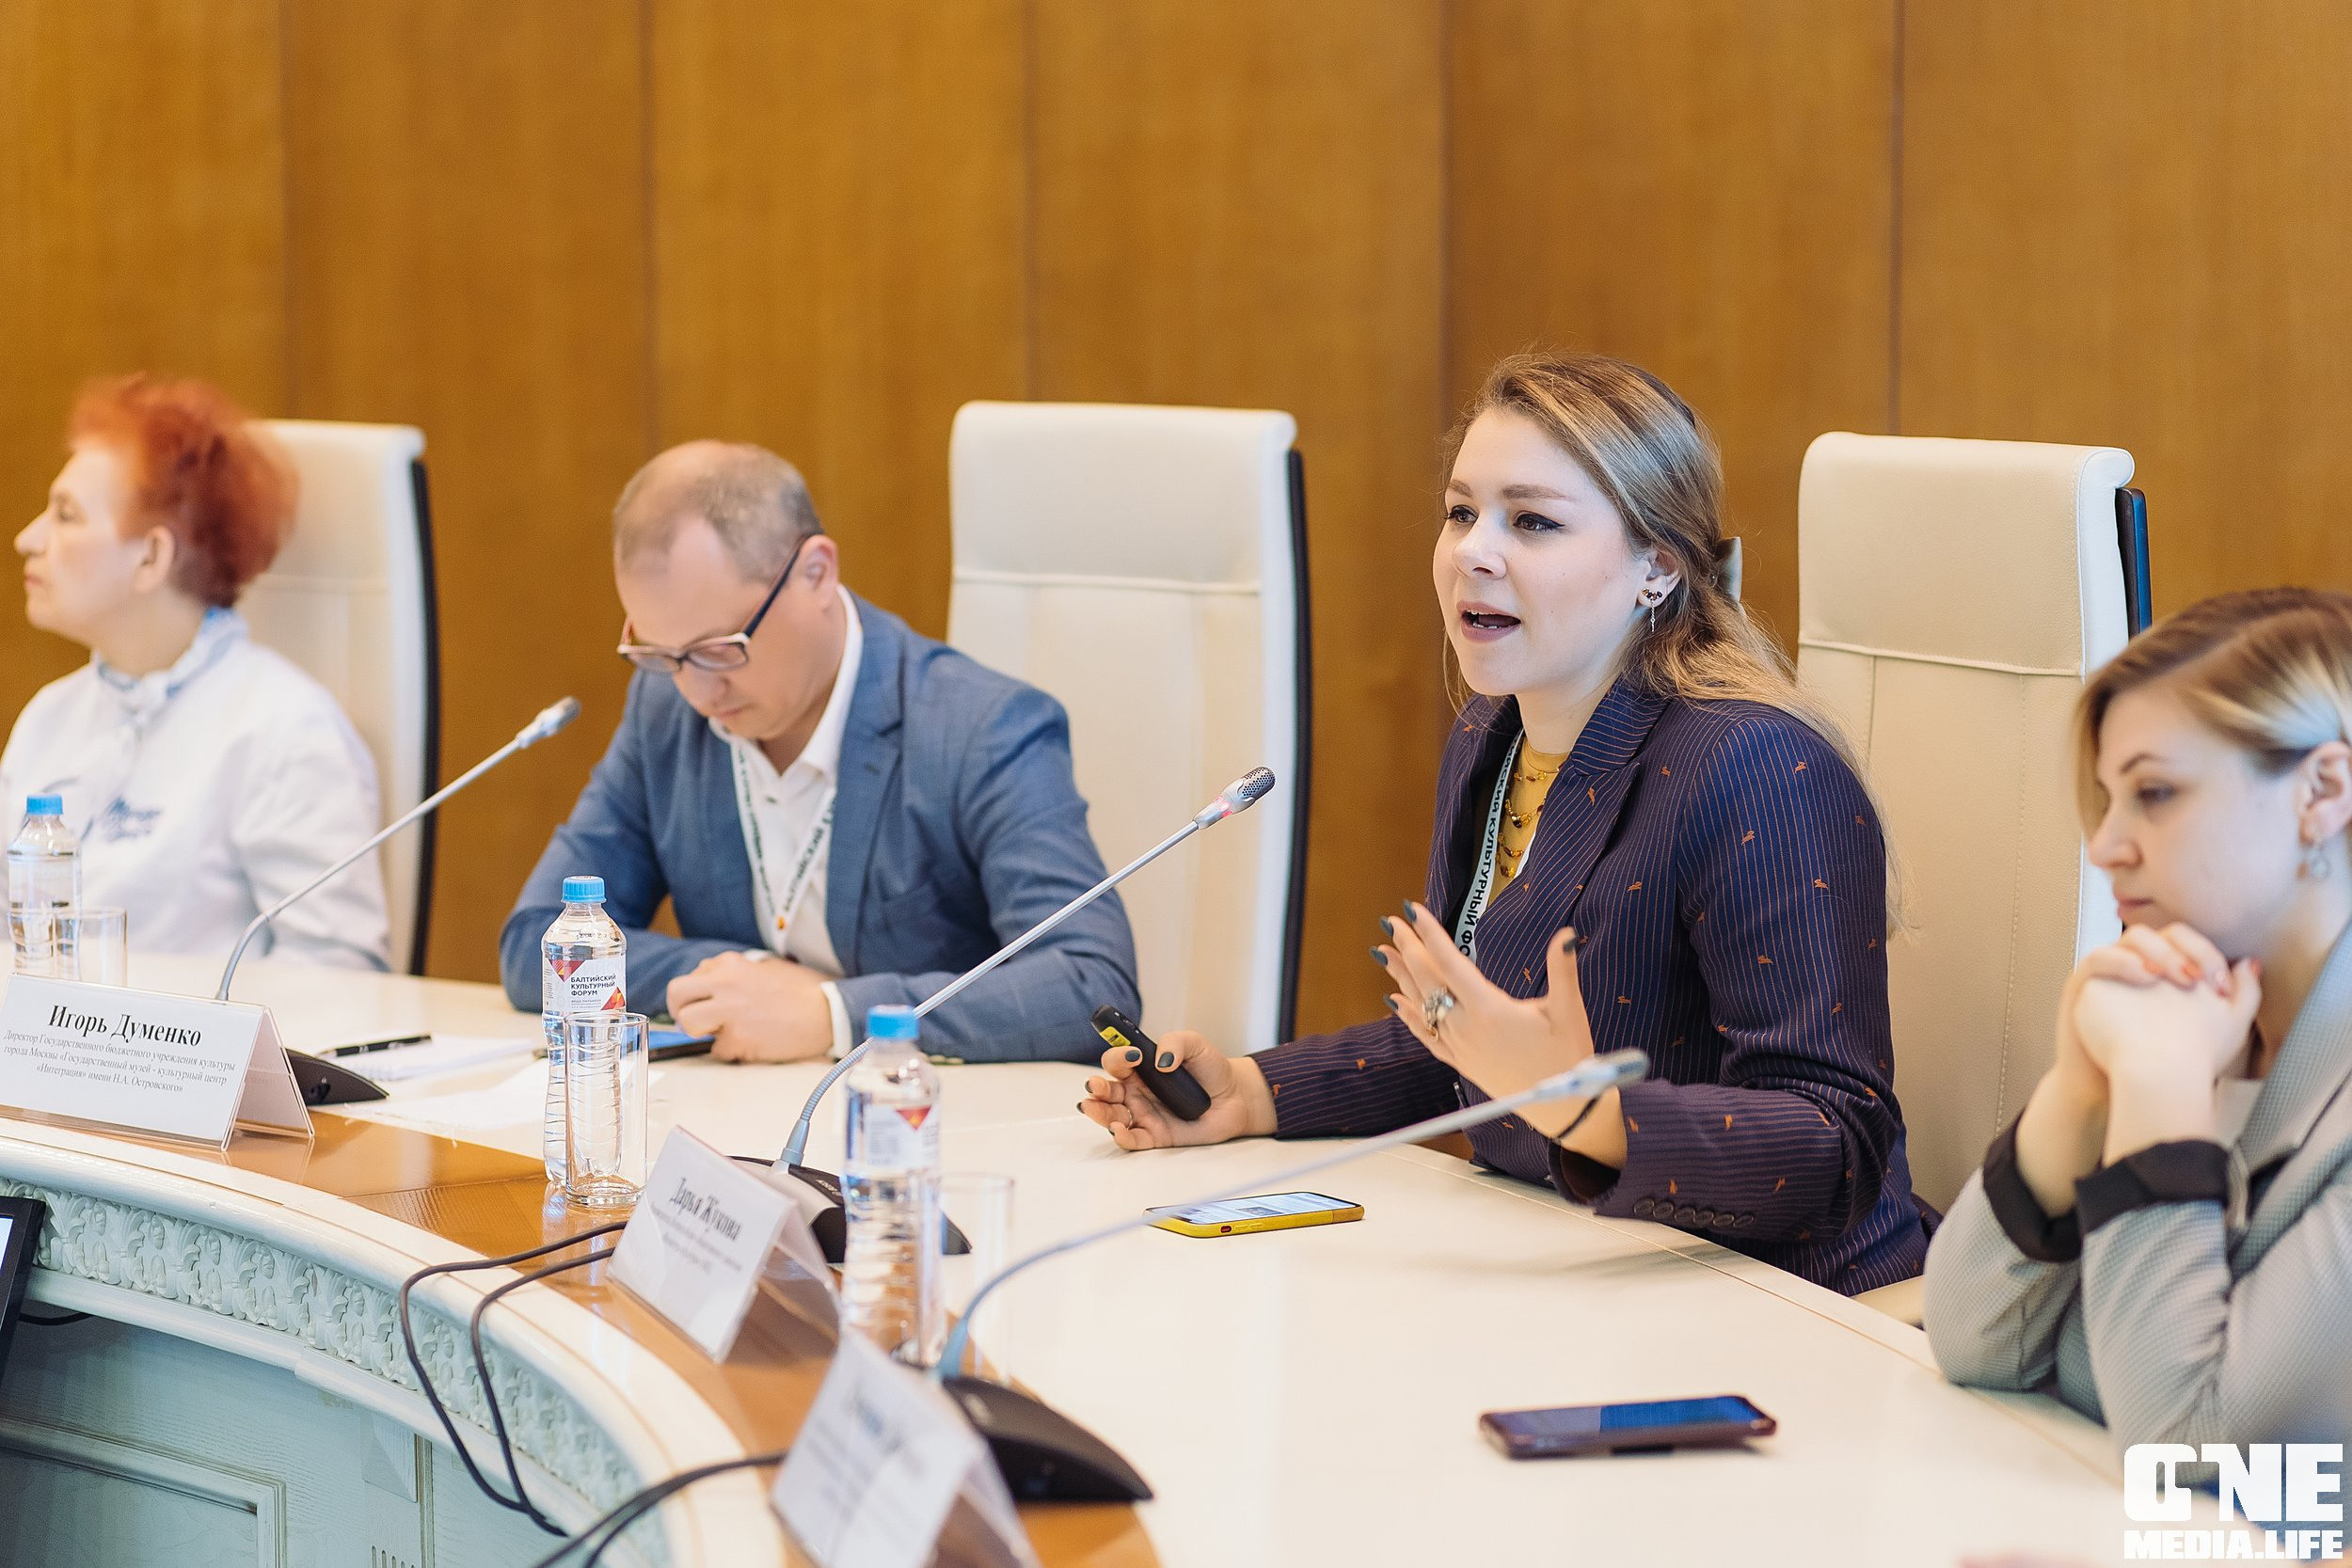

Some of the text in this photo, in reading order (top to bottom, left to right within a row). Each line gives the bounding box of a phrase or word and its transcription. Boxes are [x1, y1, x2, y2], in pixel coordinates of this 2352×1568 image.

[1464, 817, 1498, 927] КУЛЬТУРНЫЙ
[571, 974, 616, 983] БАЛТИЙСКИЙ
[571, 981, 615, 990] КУЛЬТУРНЫЙ
[47, 1005, 202, 1047] Игорь Думенко
[4, 1030, 236, 1071] Директор Государственного бюджетного учреждения культуры
[4, 1046, 28, 1056] города
[29, 1047, 58, 1060] Москвы
[59, 1052, 128, 1069] «Государственный
[129, 1062, 151, 1073] музей
[157, 1068, 203, 1082] культурный
[204, 1075, 228, 1087] центр
[37, 1063, 183, 1092] «Интеграция» имени Н.А. Островского»
[669, 1178, 703, 1216] Дарья
[700, 1195, 742, 1242] Жукова
